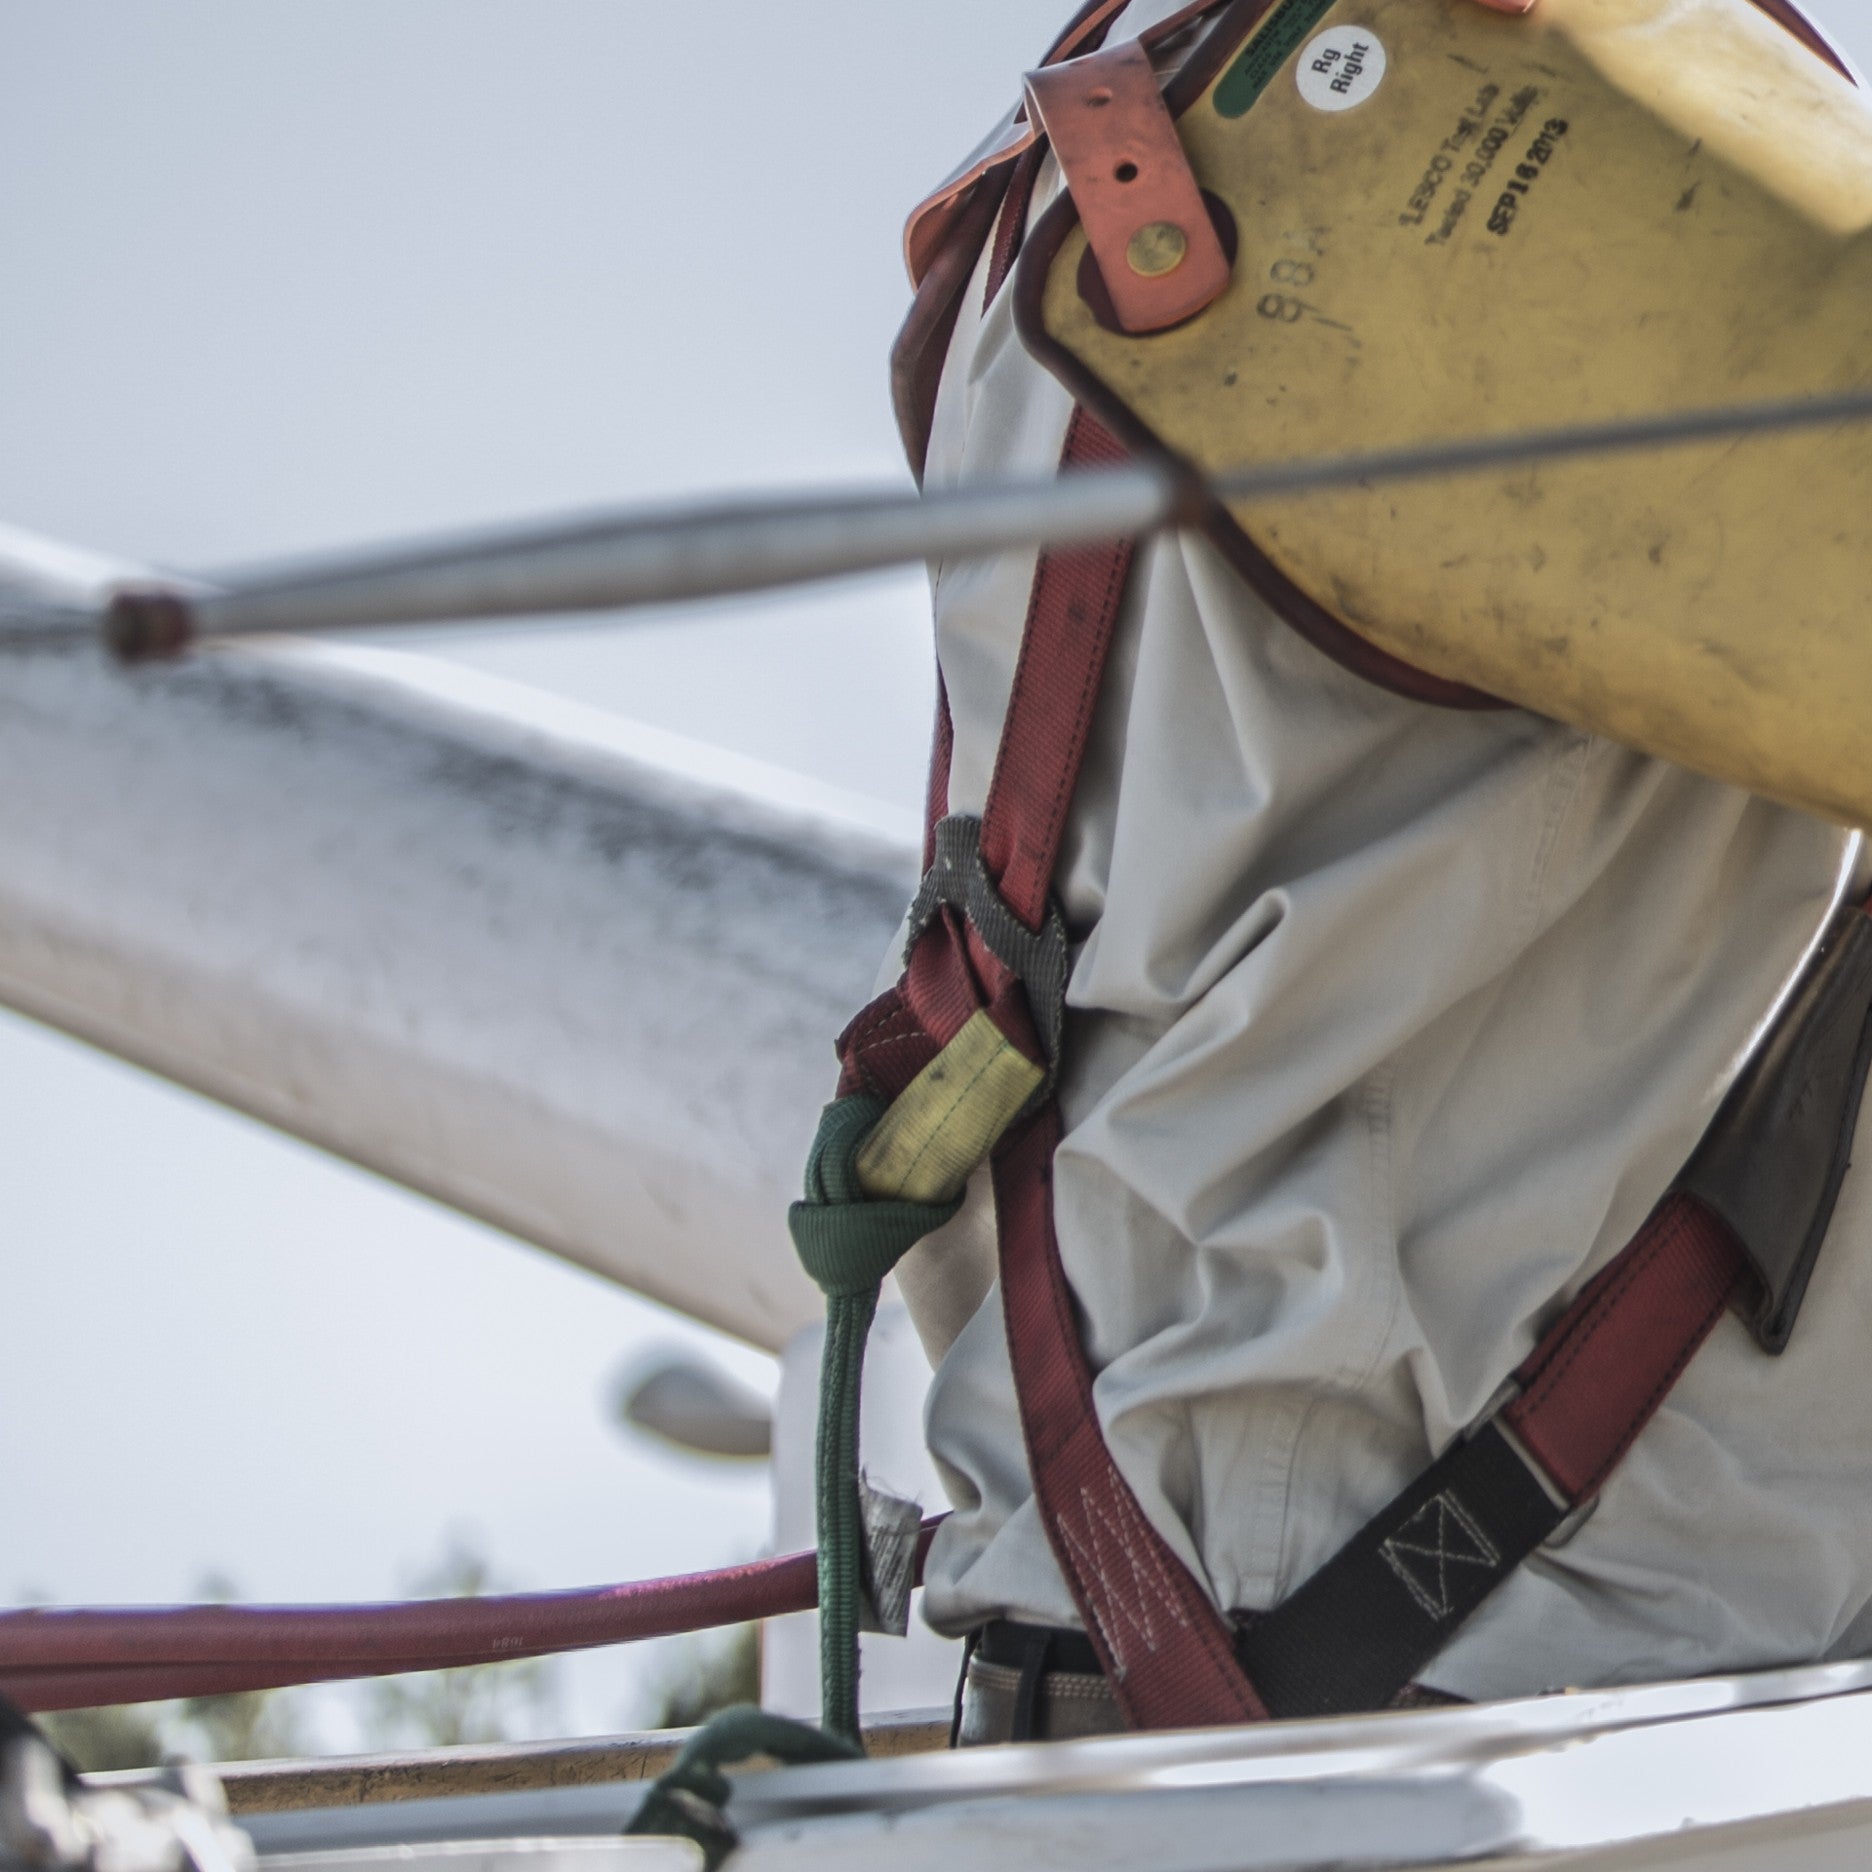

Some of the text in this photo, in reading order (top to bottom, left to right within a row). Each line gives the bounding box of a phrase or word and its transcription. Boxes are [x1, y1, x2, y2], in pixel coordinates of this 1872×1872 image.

[1311, 48, 1341, 74] Rg
[1329, 42, 1369, 94] Right
[1486, 193, 1520, 236] SEP
[1526, 117, 1569, 165] 2013
